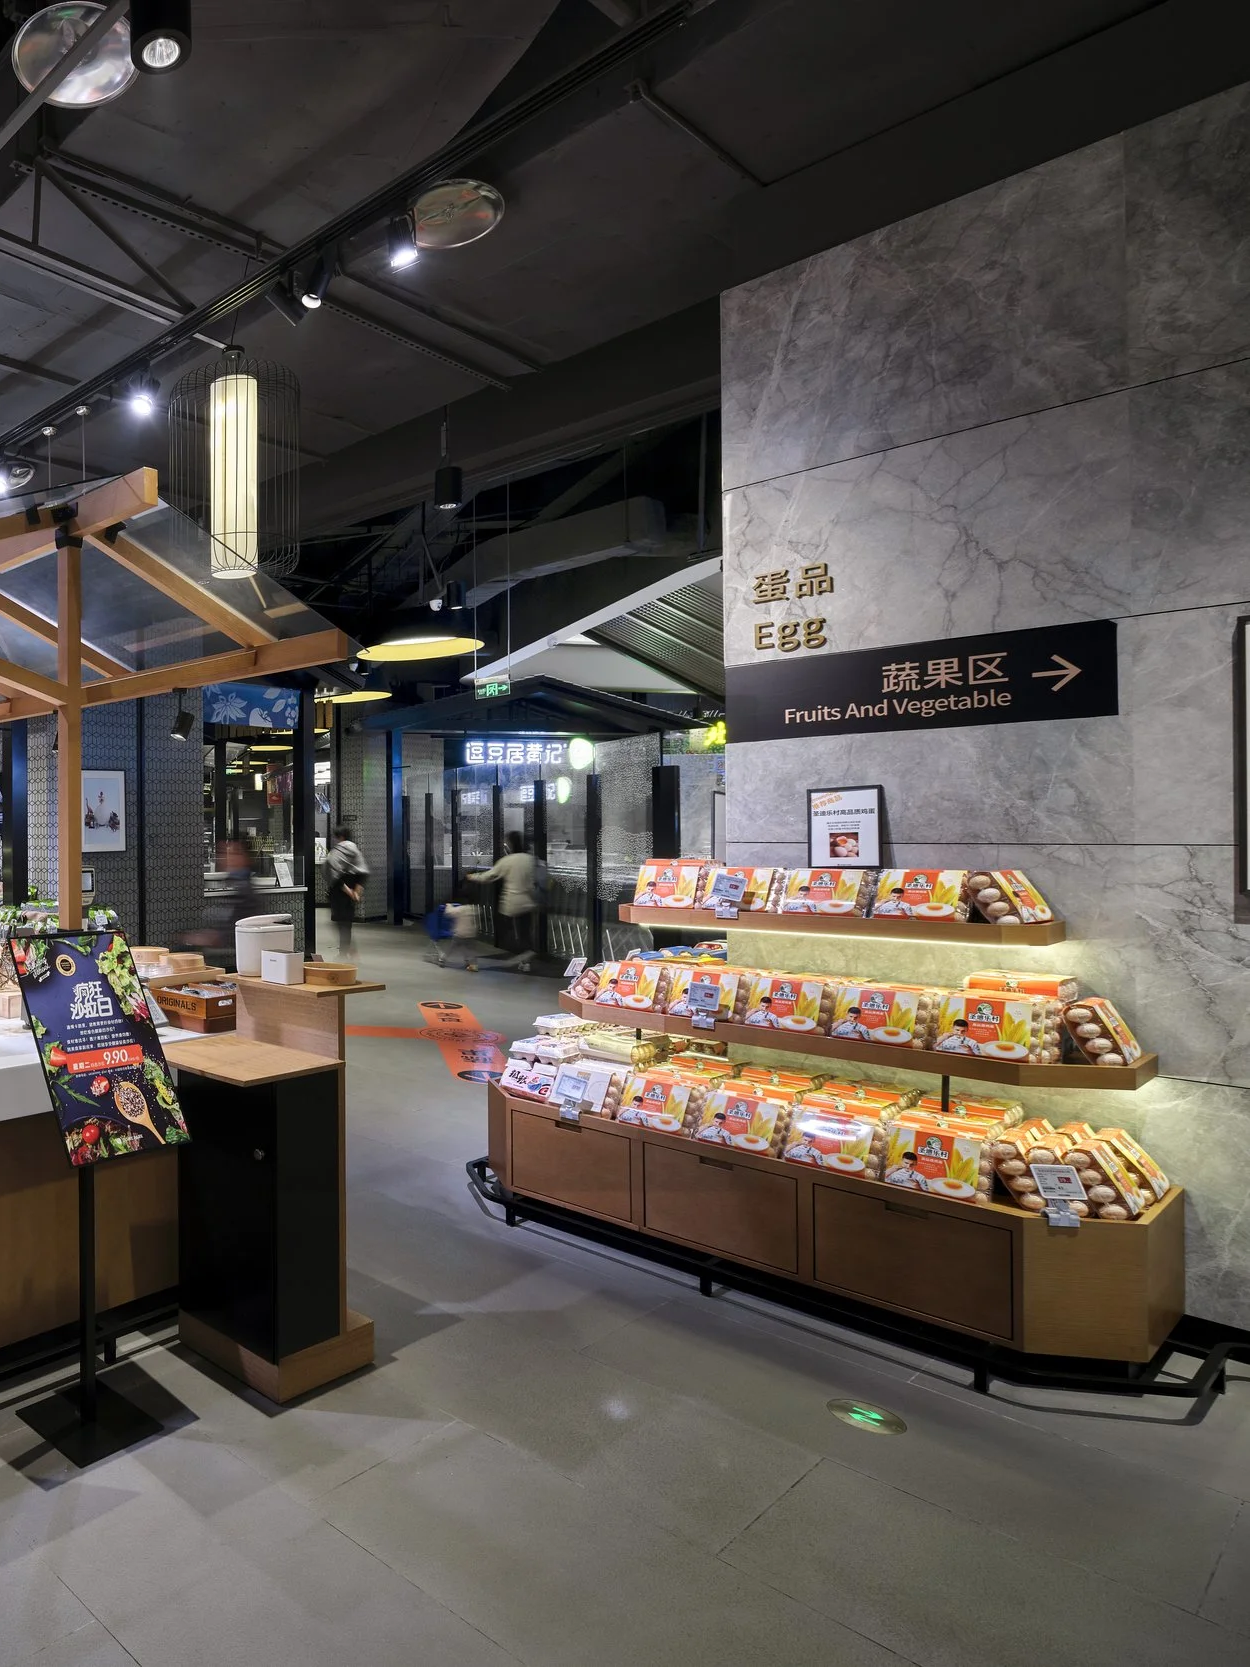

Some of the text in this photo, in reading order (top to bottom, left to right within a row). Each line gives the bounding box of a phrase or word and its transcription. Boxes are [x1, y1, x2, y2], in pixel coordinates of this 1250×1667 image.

[752, 561, 835, 605] 蛋品
[753, 615, 829, 653] Egg
[881, 651, 1010, 695] 蔬果区
[784, 689, 1013, 724] Fruits And Vegetable
[72, 981, 104, 1004] 疯狂
[157, 996, 197, 1011] ORIGINALS
[70, 997, 114, 1020] 沙拉日
[103, 1049, 129, 1065] 9.90
